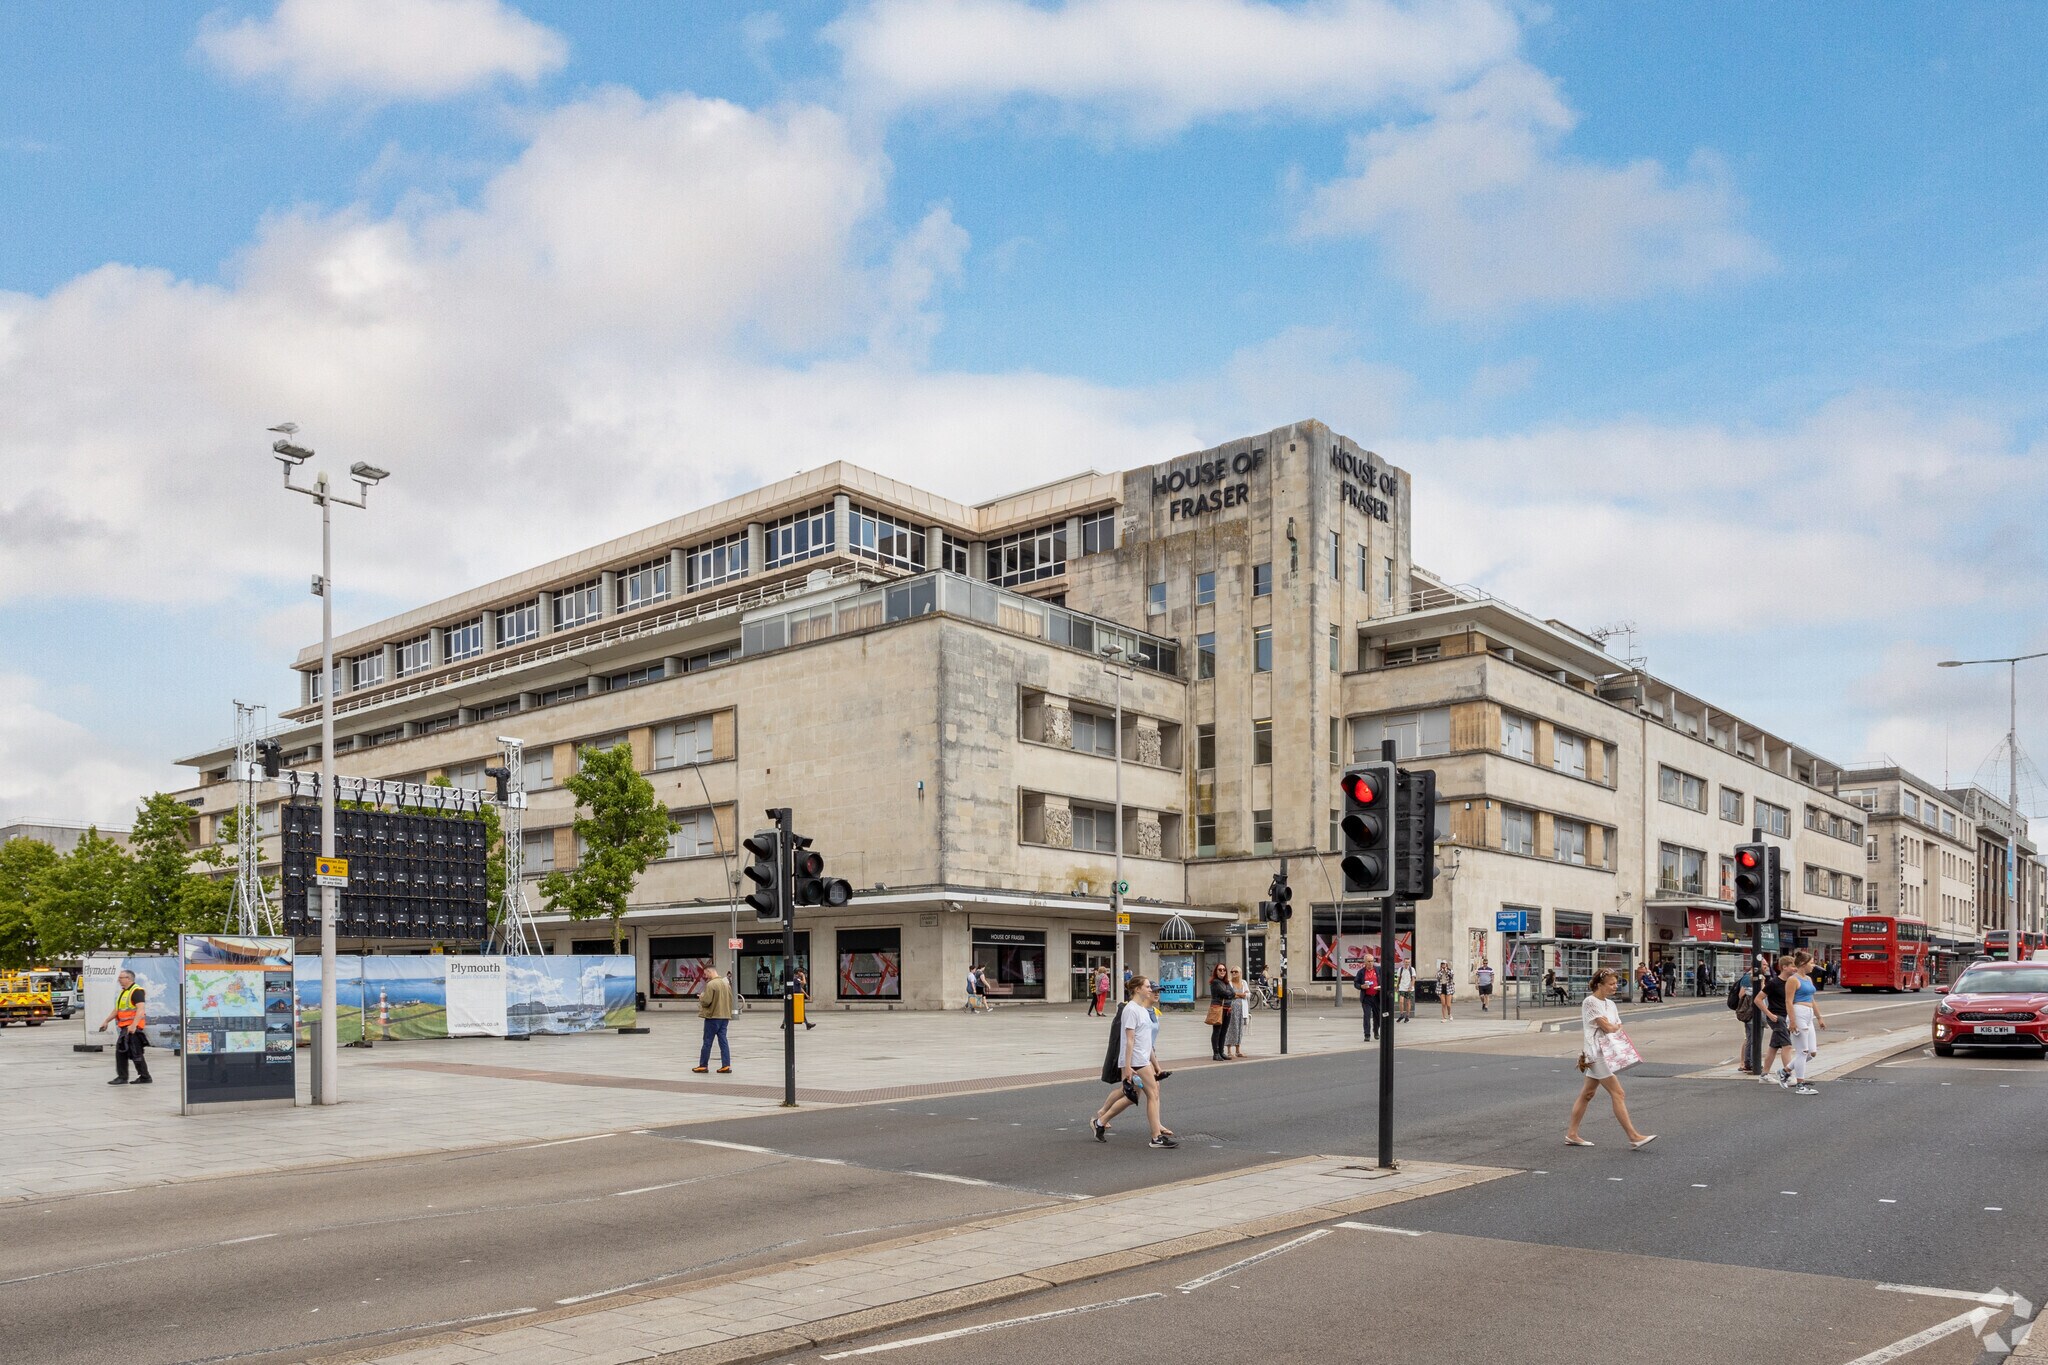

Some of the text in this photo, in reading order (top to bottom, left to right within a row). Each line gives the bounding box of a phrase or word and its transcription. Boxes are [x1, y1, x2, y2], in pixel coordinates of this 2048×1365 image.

[1152, 448, 1264, 497] HOUSE OF
[1332, 445, 1398, 497] HOUSE OF
[1170, 482, 1249, 522] FRASER
[1342, 480, 1389, 523] FRASER
[1347, 945, 1382, 959] SAL
[1859, 952, 1873, 960] city
[84, 964, 117, 977] Plymouth
[450, 963, 501, 975] Plymouth
[265, 1054, 292, 1062] Plymouth
